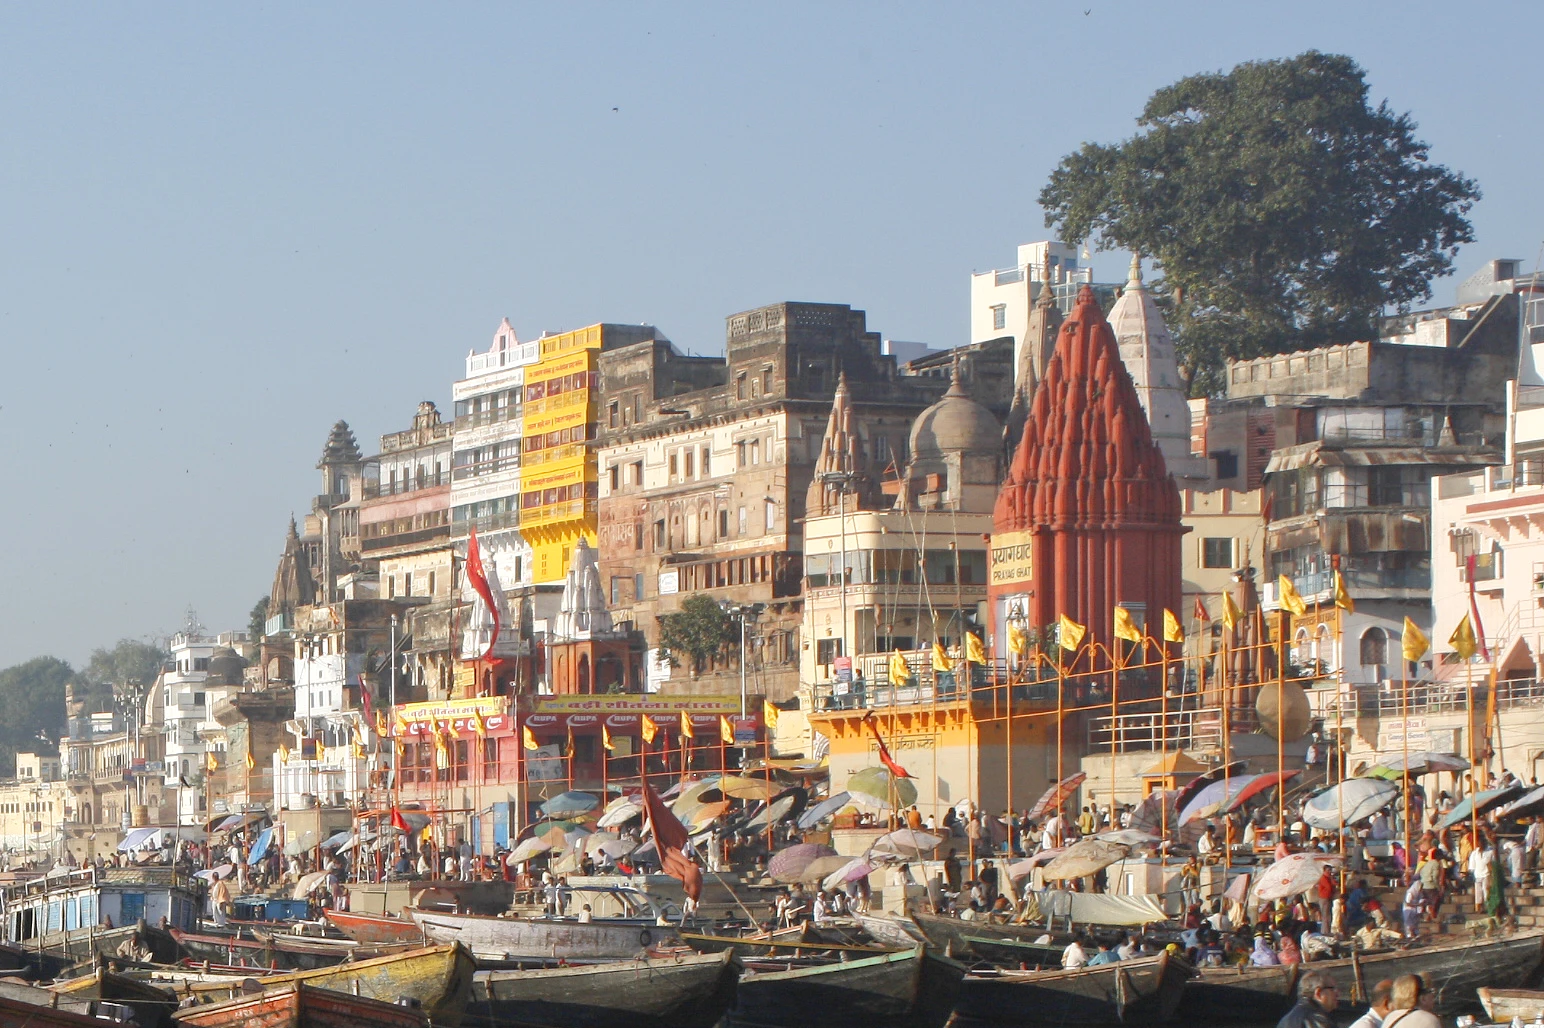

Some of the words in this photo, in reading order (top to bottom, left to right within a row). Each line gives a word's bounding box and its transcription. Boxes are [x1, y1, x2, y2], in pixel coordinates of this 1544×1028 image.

[991, 546, 1016, 568] प्रयाग
[1016, 543, 1031, 561] घाट
[993, 568, 1015, 581] PRAYAG
[1016, 566, 1031, 578] GHAT
